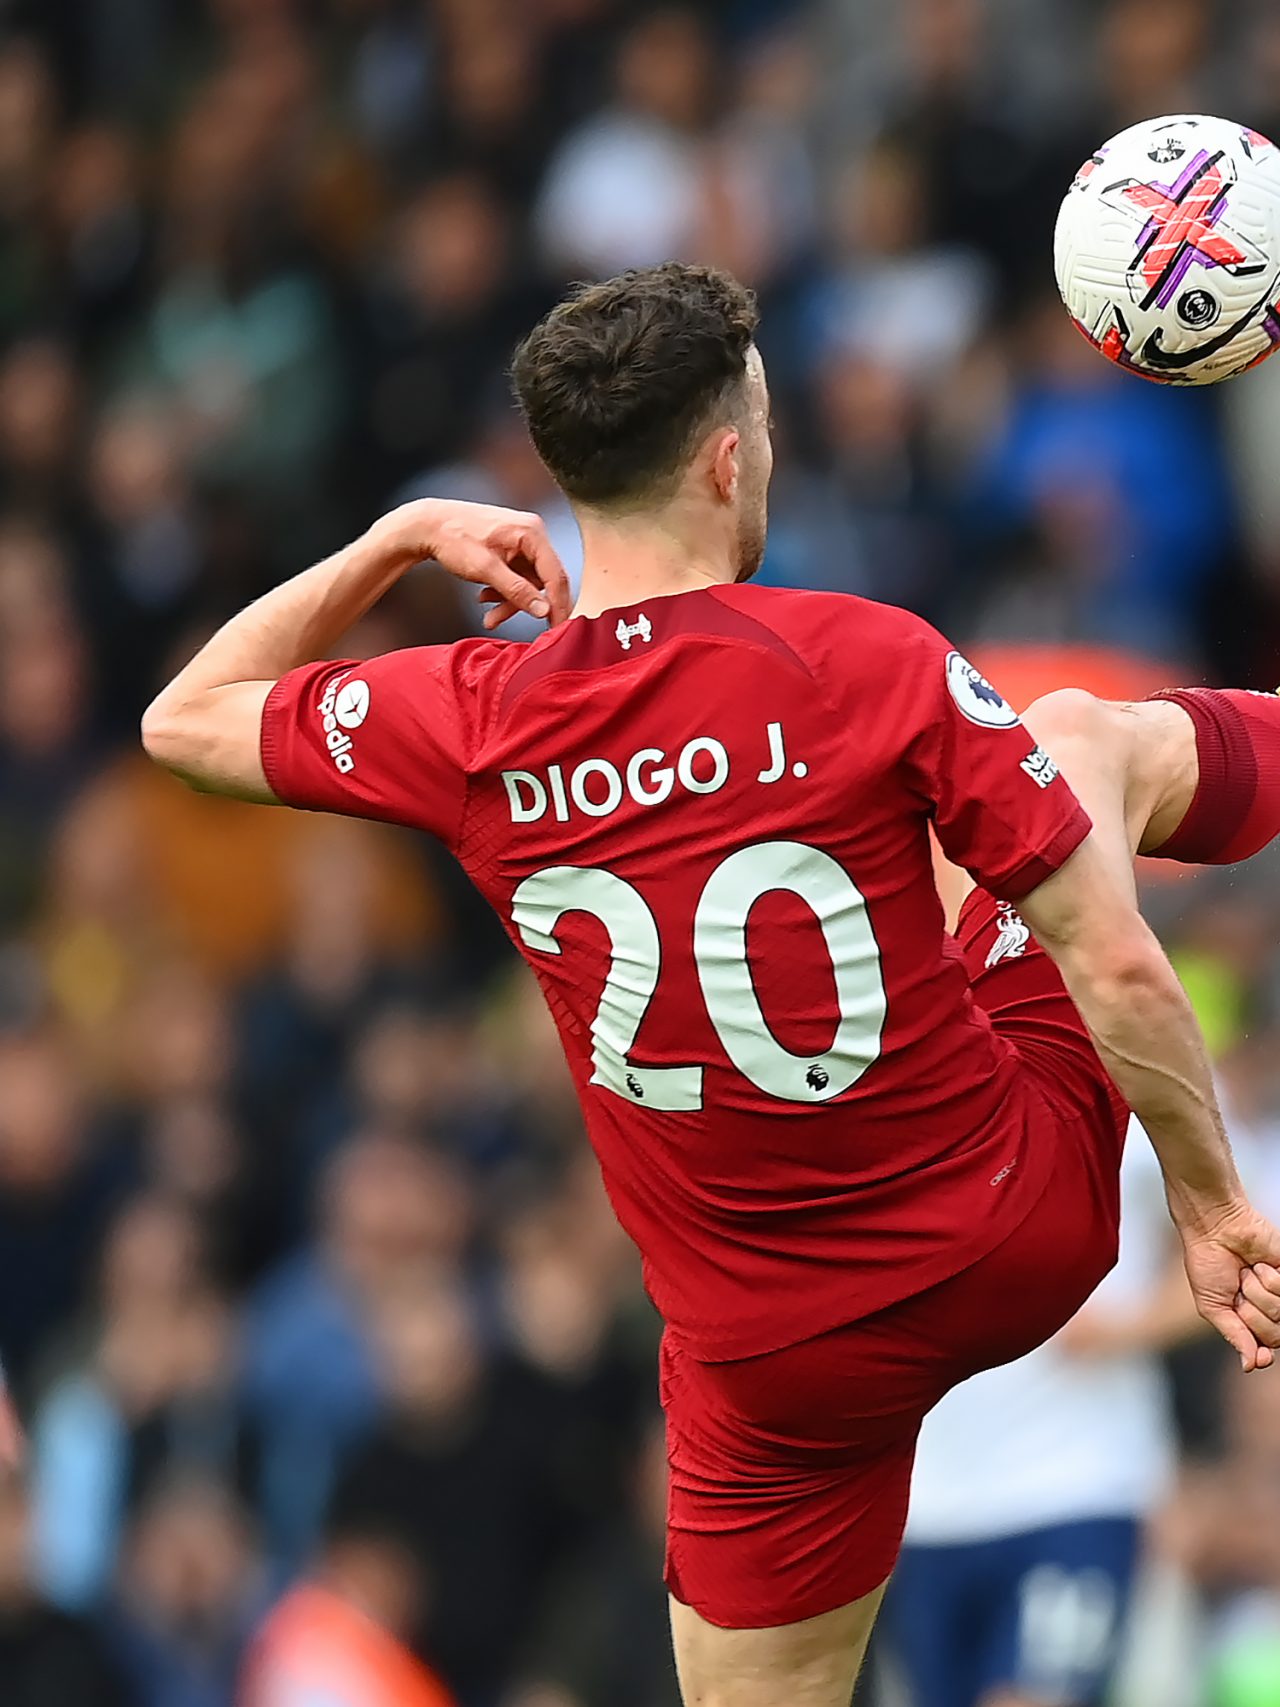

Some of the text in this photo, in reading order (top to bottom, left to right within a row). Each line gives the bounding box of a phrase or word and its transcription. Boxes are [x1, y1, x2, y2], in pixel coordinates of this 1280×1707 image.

[501, 722, 808, 823] DIOGO J.
[511, 841, 887, 1112] 20
